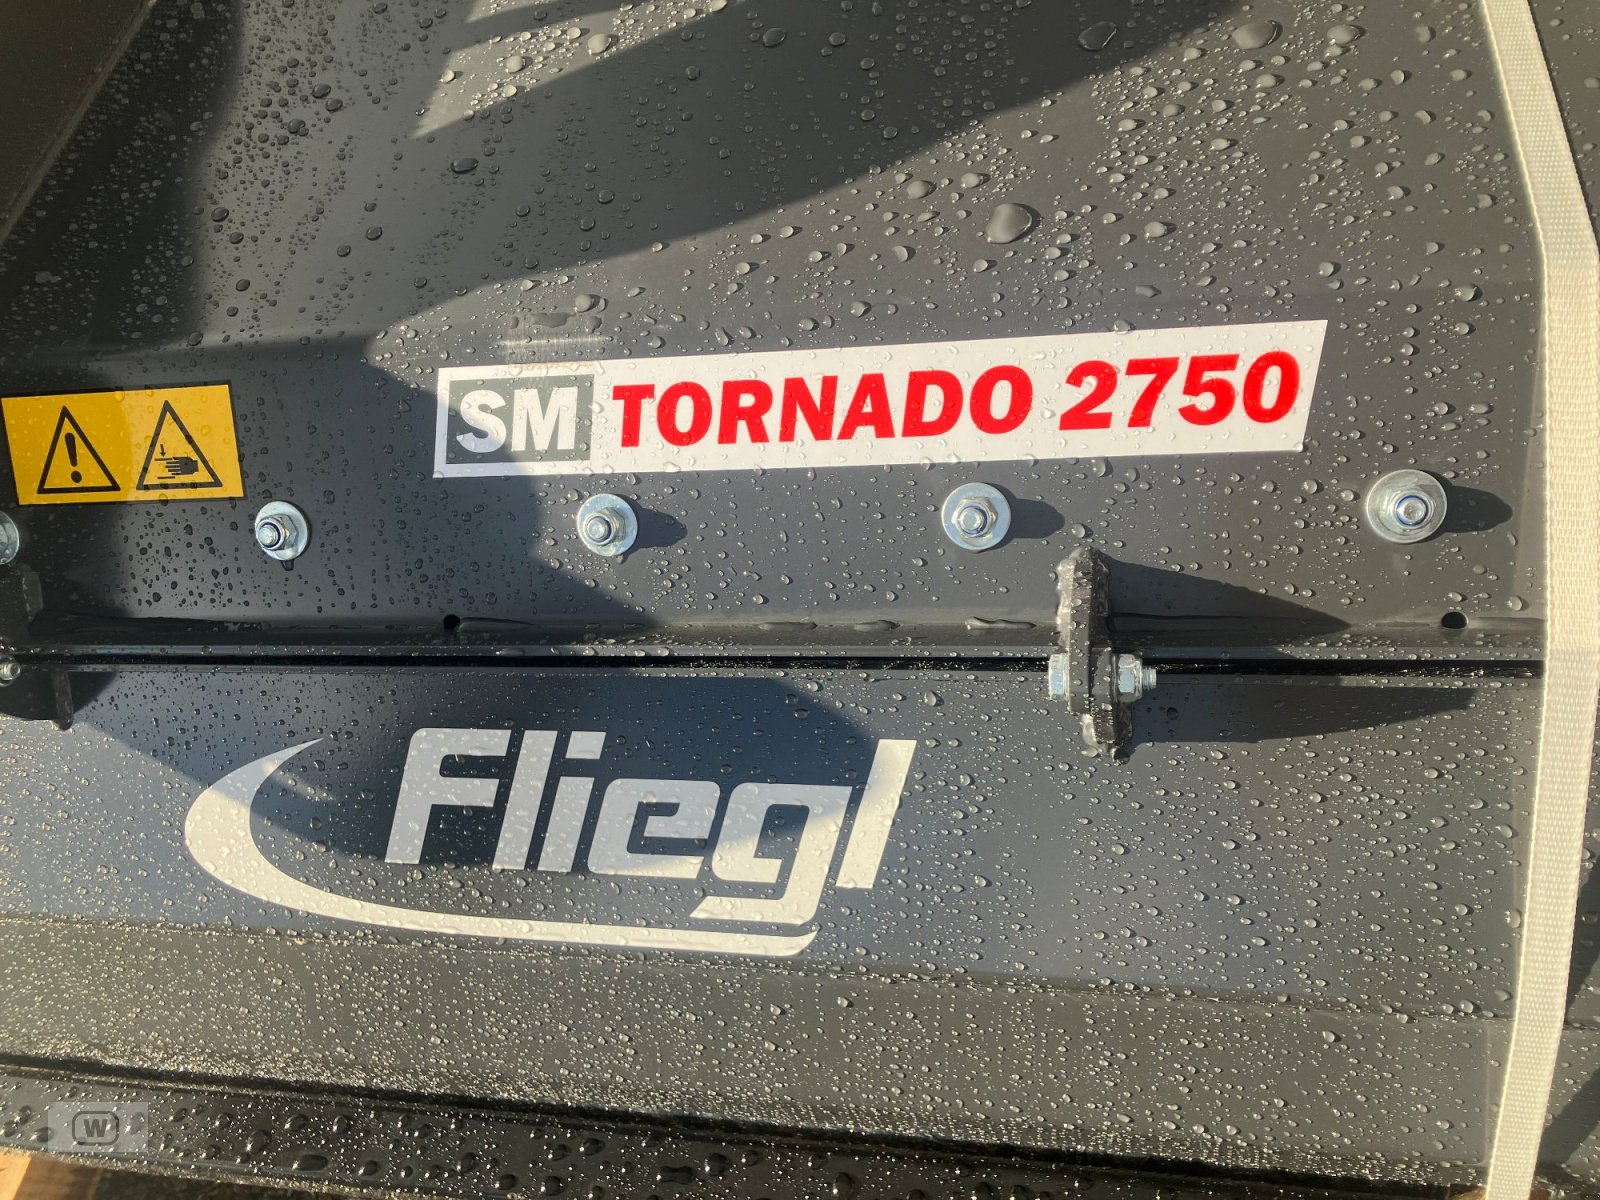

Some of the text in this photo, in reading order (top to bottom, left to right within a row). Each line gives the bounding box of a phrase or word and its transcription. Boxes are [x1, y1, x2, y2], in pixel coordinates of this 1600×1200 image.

[456, 351, 1300, 453] SM TORNADO 2750
[384, 727, 917, 925] Fliegl
